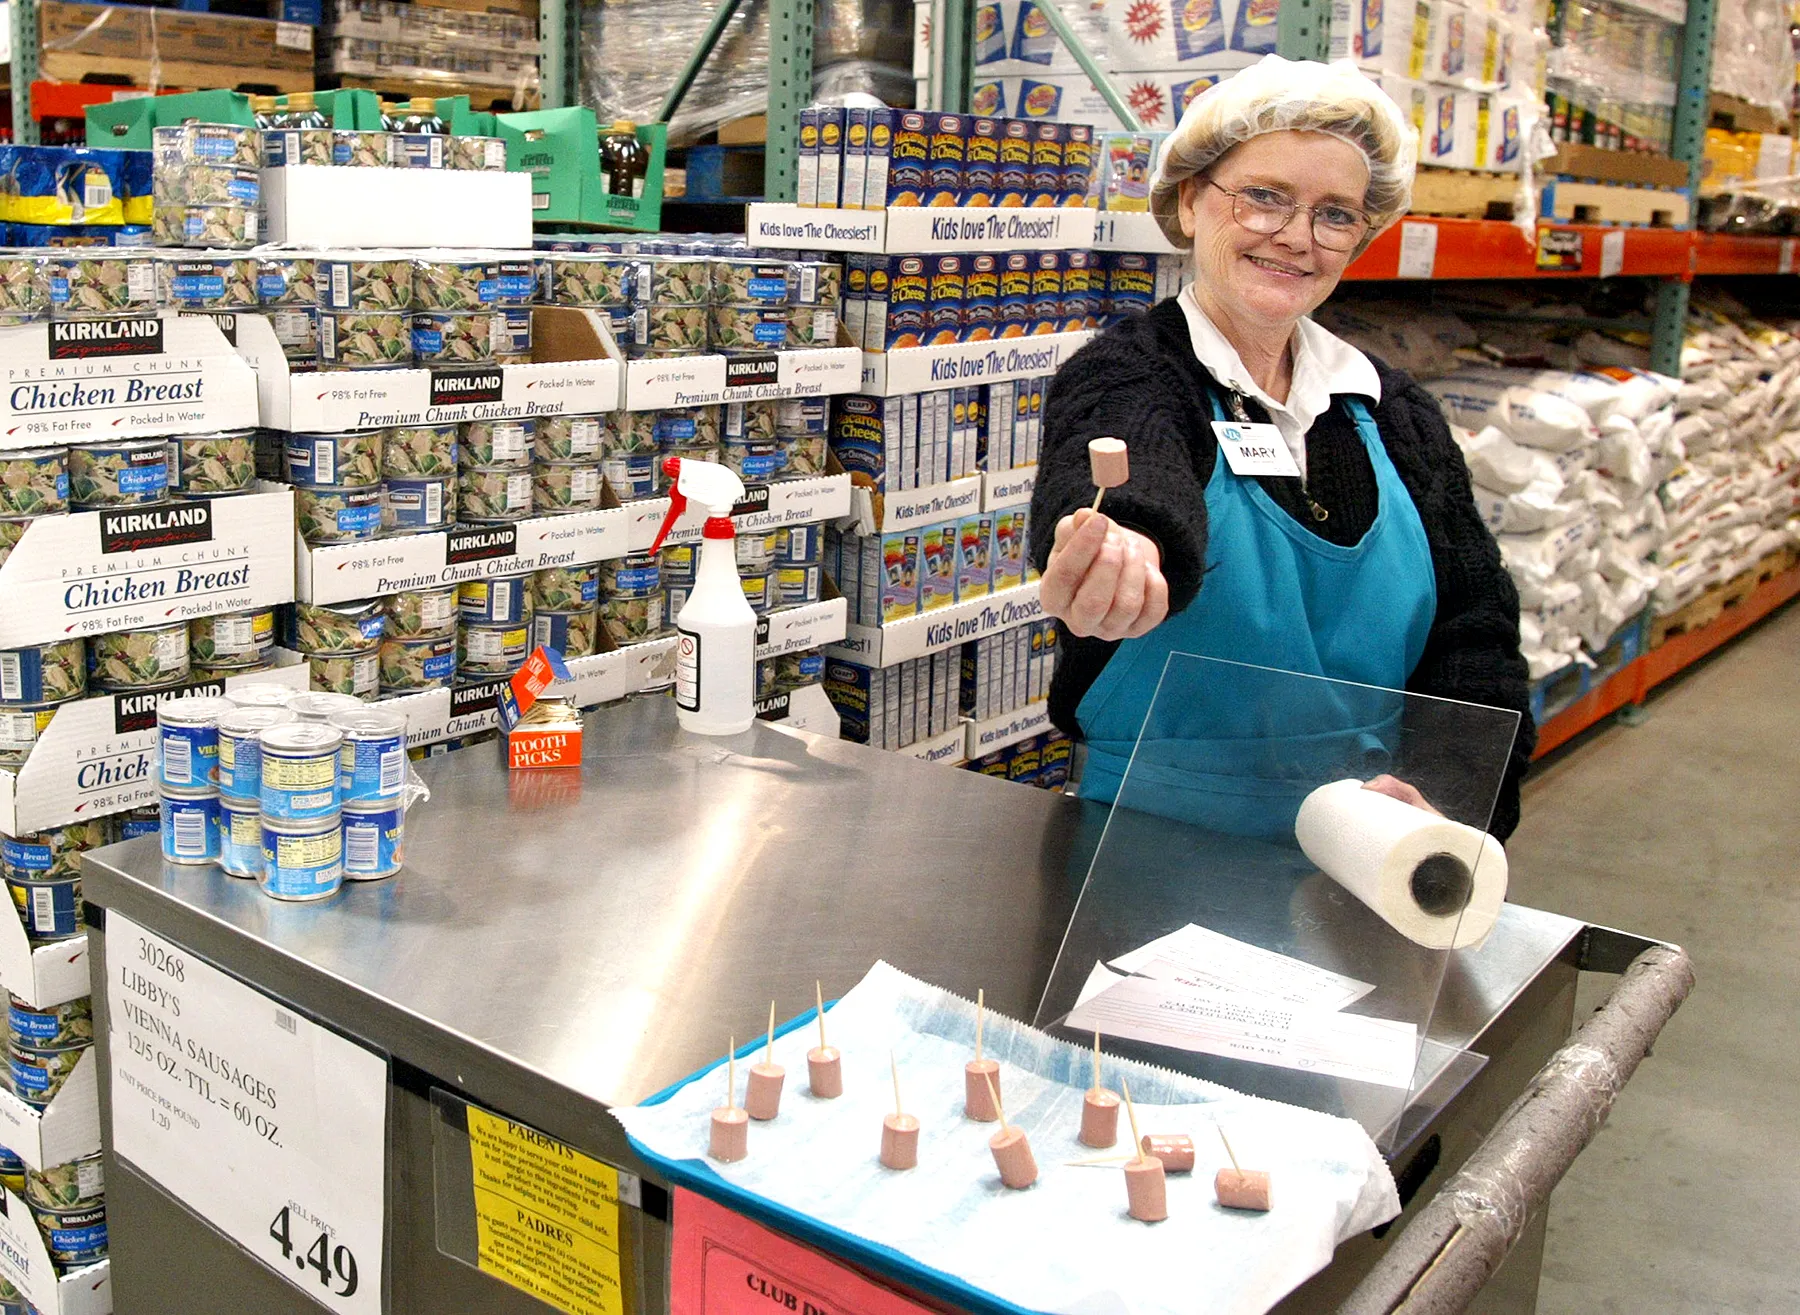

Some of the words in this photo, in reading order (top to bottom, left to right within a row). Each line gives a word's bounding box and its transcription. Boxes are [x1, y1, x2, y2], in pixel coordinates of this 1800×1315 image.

[760, 222, 781, 236] Kids
[782, 223, 804, 237] love
[804, 222, 822, 239] The
[931, 216, 957, 240] Kids
[960, 216, 984, 239] love
[987, 214, 1005, 239] The
[178, 264, 213, 272] KIRKLAND
[198, 283, 222, 291] Breast
[54, 318, 159, 341] KIRKLAND
[9, 363, 112, 378] PREMIUM
[134, 359, 204, 372] CHUNK
[728, 361, 777, 376] KIRKLAND
[804, 363, 824, 372] Packed
[931, 358, 957, 381] Kids
[959, 357, 984, 377] love
[985, 350, 1004, 374] The
[434, 375, 501, 392] KIRKLAND
[539, 378, 564, 389] Packed
[566, 378, 574, 388] In
[575, 377, 596, 388] Water
[672, 374, 682, 382] Fat
[682, 373, 695, 381] Free
[10, 380, 116, 412] Chicken
[126, 376, 205, 403] Breast
[332, 390, 351, 400] 98%
[354, 390, 367, 399] Fat
[368, 389, 387, 399] Free
[674, 391, 719, 405] Premium
[722, 387, 753, 401] Chunk
[756, 384, 792, 398] Chicken
[795, 382, 823, 394] Breast
[130, 413, 163, 425] Packed
[166, 413, 175, 422] In
[179, 411, 206, 422] Water
[358, 410, 421, 427] Premium
[425, 406, 469, 423] Chunk
[472, 402, 524, 420] Chicken
[526, 401, 564, 415] Breast
[27, 423, 49, 433] 98%
[53, 422, 68, 432] Fat
[71, 420, 92, 430] Free
[841, 426, 882, 444] Cheese
[131, 451, 165, 462] KIRKLAND
[1240, 446, 1276, 458] MARY
[120, 473, 151, 485] Chicken
[993, 486, 1008, 500] Kids
[1009, 483, 1024, 497] love
[339, 512, 368, 525] Chicken
[896, 504, 914, 520] Kids
[915, 500, 930, 516] love
[931, 498, 943, 514] The
[105, 506, 209, 535] KIRKLAND
[665, 524, 703, 541] Premiu
[744, 510, 783, 529] Chicken
[785, 507, 813, 522] Breast
[450, 531, 515, 552] KIRKLAND
[550, 530, 574, 540] Packed
[576, 529, 583, 537] In
[585, 525, 606, 535] Water
[62, 557, 163, 578] PREMIUM
[181, 546, 251, 562] CHUNK
[351, 559, 370, 570] 98%
[373, 557, 386, 568] Fat
[386, 555, 405, 566] Free
[377, 574, 437, 594] Premium
[441, 567, 483, 587] Chunk
[486, 557, 535, 578] Chicken
[538, 550, 576, 565] Breast
[64, 577, 167, 610] Chicken
[174, 563, 251, 594] Breast
[181, 602, 212, 615] Packed
[215, 601, 223, 610] In
[226, 597, 253, 608] Water
[82, 621, 103, 631] 98%
[106, 617, 122, 627] Fat
[124, 614, 145, 625] Free
[925, 624, 952, 648] Kids
[954, 618, 978, 639] love
[980, 607, 1000, 631] The
[784, 634, 812, 650] Breast
[454, 681, 510, 705] KIRKLAN
[446, 713, 486, 735] Chunk
[77, 735, 158, 758] PREMIU
[511, 734, 567, 755] TOOTH
[980, 732, 995, 746] Kids
[514, 749, 562, 768] PICKS
[78, 753, 150, 789] Chick
[93, 797, 115, 811] 98%
[117, 793, 132, 805] Fat
[135, 789, 155, 801] Free
[23, 852, 50, 862] Breast
[137, 937, 187, 983] 30268
[121, 966, 183, 1018] LIBBY'S
[122, 998, 184, 1053] VIENNA
[186, 1040, 279, 1110] SAUSAGES
[119, 1067, 137, 1088] UNIT
[136, 1078, 158, 1103] PRICE
[157, 1091, 172, 1110] PER
[172, 1100, 201, 1130] POUND
[126, 1029, 155, 1064] 12/5
[156, 1048, 184, 1083] OZ.
[185, 1066, 217, 1106] TTL
[233, 1101, 252, 1129] 60
[254, 1114, 284, 1149] OZ.
[150, 1106, 172, 1132] 1.20
[507, 1122, 573, 1160] PARENTS
[498, 1134, 517, 1152] happy
[544, 1156, 559, 1170] your
[561, 1162, 576, 1176] child
[62, 1212, 104, 1225] KIRKLAND
[287, 1199, 311, 1222] SELL
[310, 1212, 338, 1240] PRICE
[517, 1209, 574, 1248] PADRES
[53, 1234, 87, 1244] Chicken
[0, 1239, 30, 1275] reast
[269, 1205, 360, 1298] 4.49
[746, 1272, 797, 1311] CLUB
